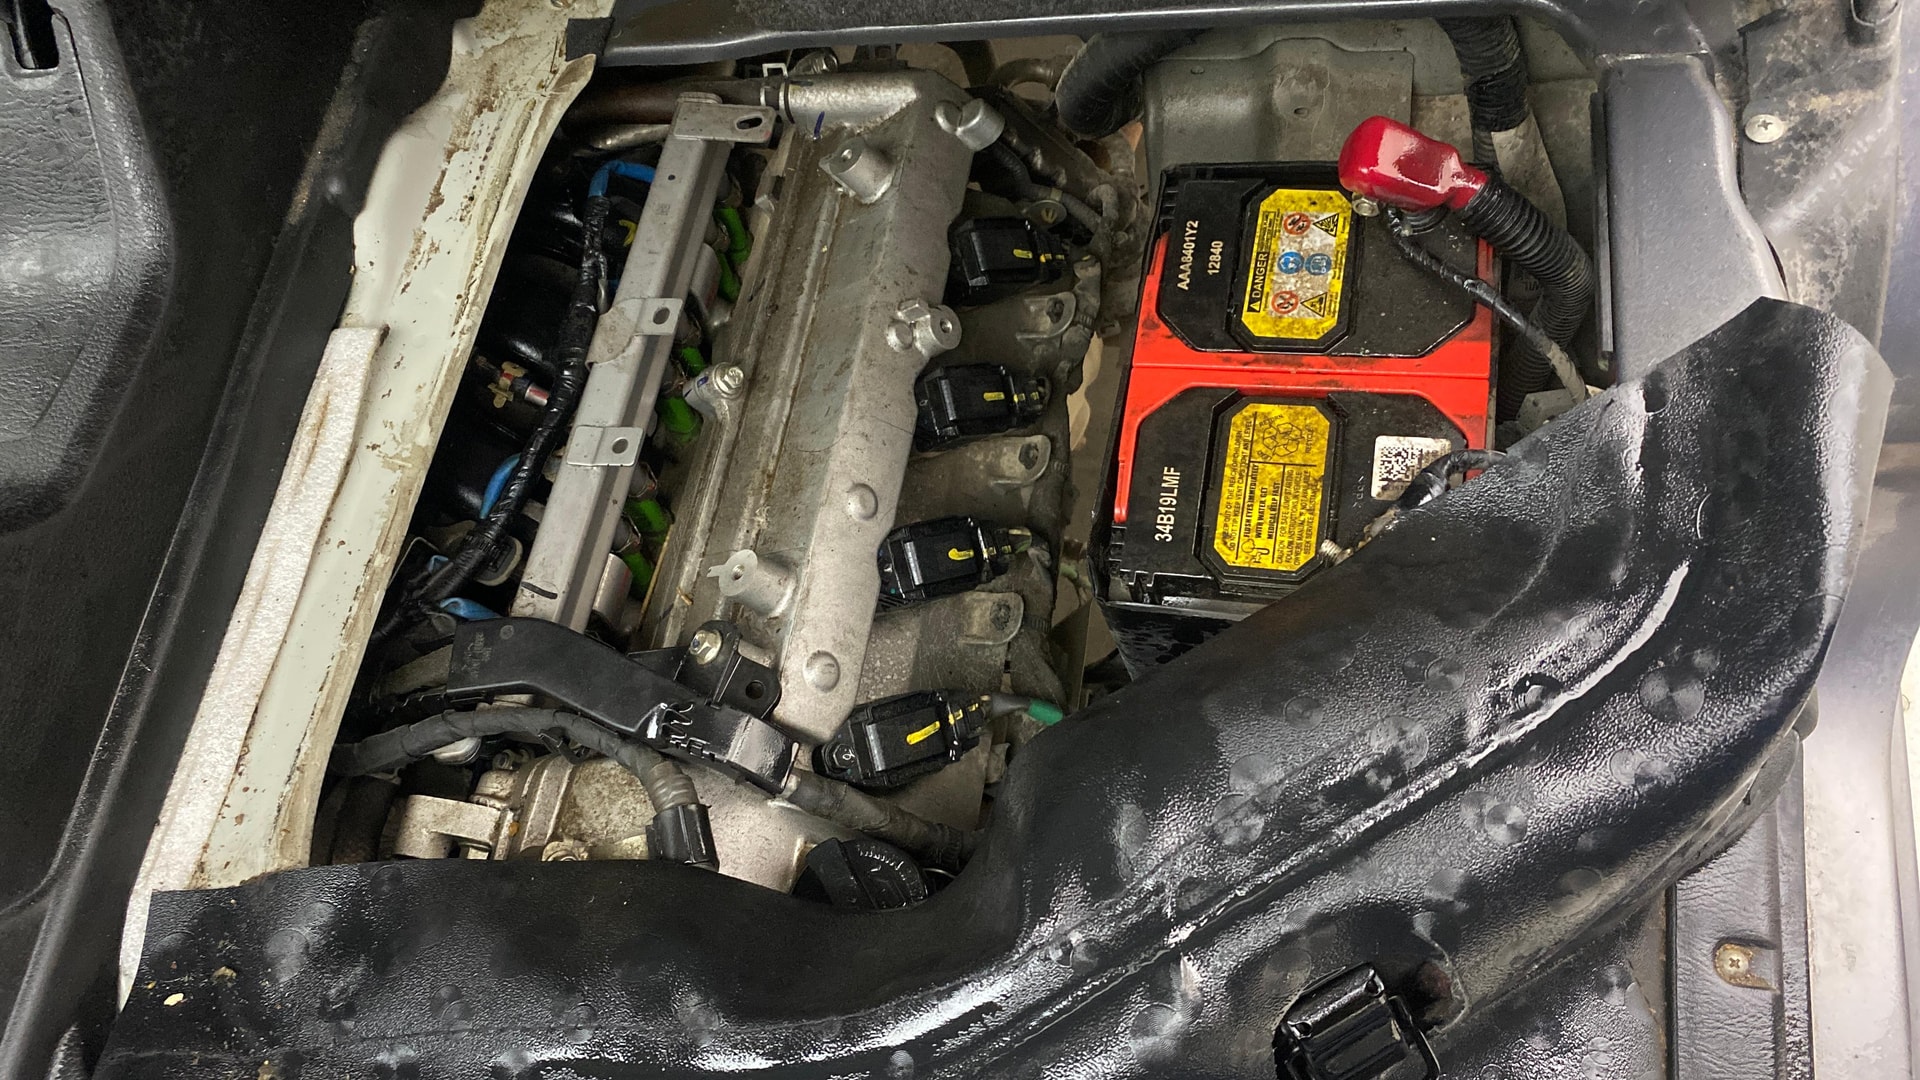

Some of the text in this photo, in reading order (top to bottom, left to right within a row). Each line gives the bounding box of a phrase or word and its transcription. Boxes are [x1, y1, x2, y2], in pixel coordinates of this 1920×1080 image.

[1177, 219, 1200, 291] AAA8401Y2
[1207, 240, 1224, 275] 12840
[1251, 253, 1268, 299] DANGER
[1304, 424, 1315, 454] RECYCLE
[1228, 467, 1236, 487] REACH
[1154, 466, 1181, 542] 34B19LMF
[1225, 500, 1232, 509] OF
[1243, 464, 1258, 537] FLUSH EYES IMMEDIATELY
[1266, 482, 1280, 539] MEDICAL HELP FAST
[1282, 495, 1290, 509] JUMP
[1255, 521, 1263, 538] WITH
[1280, 511, 1288, 524] SAFE
[1284, 540, 1293, 562] FOLLOW
